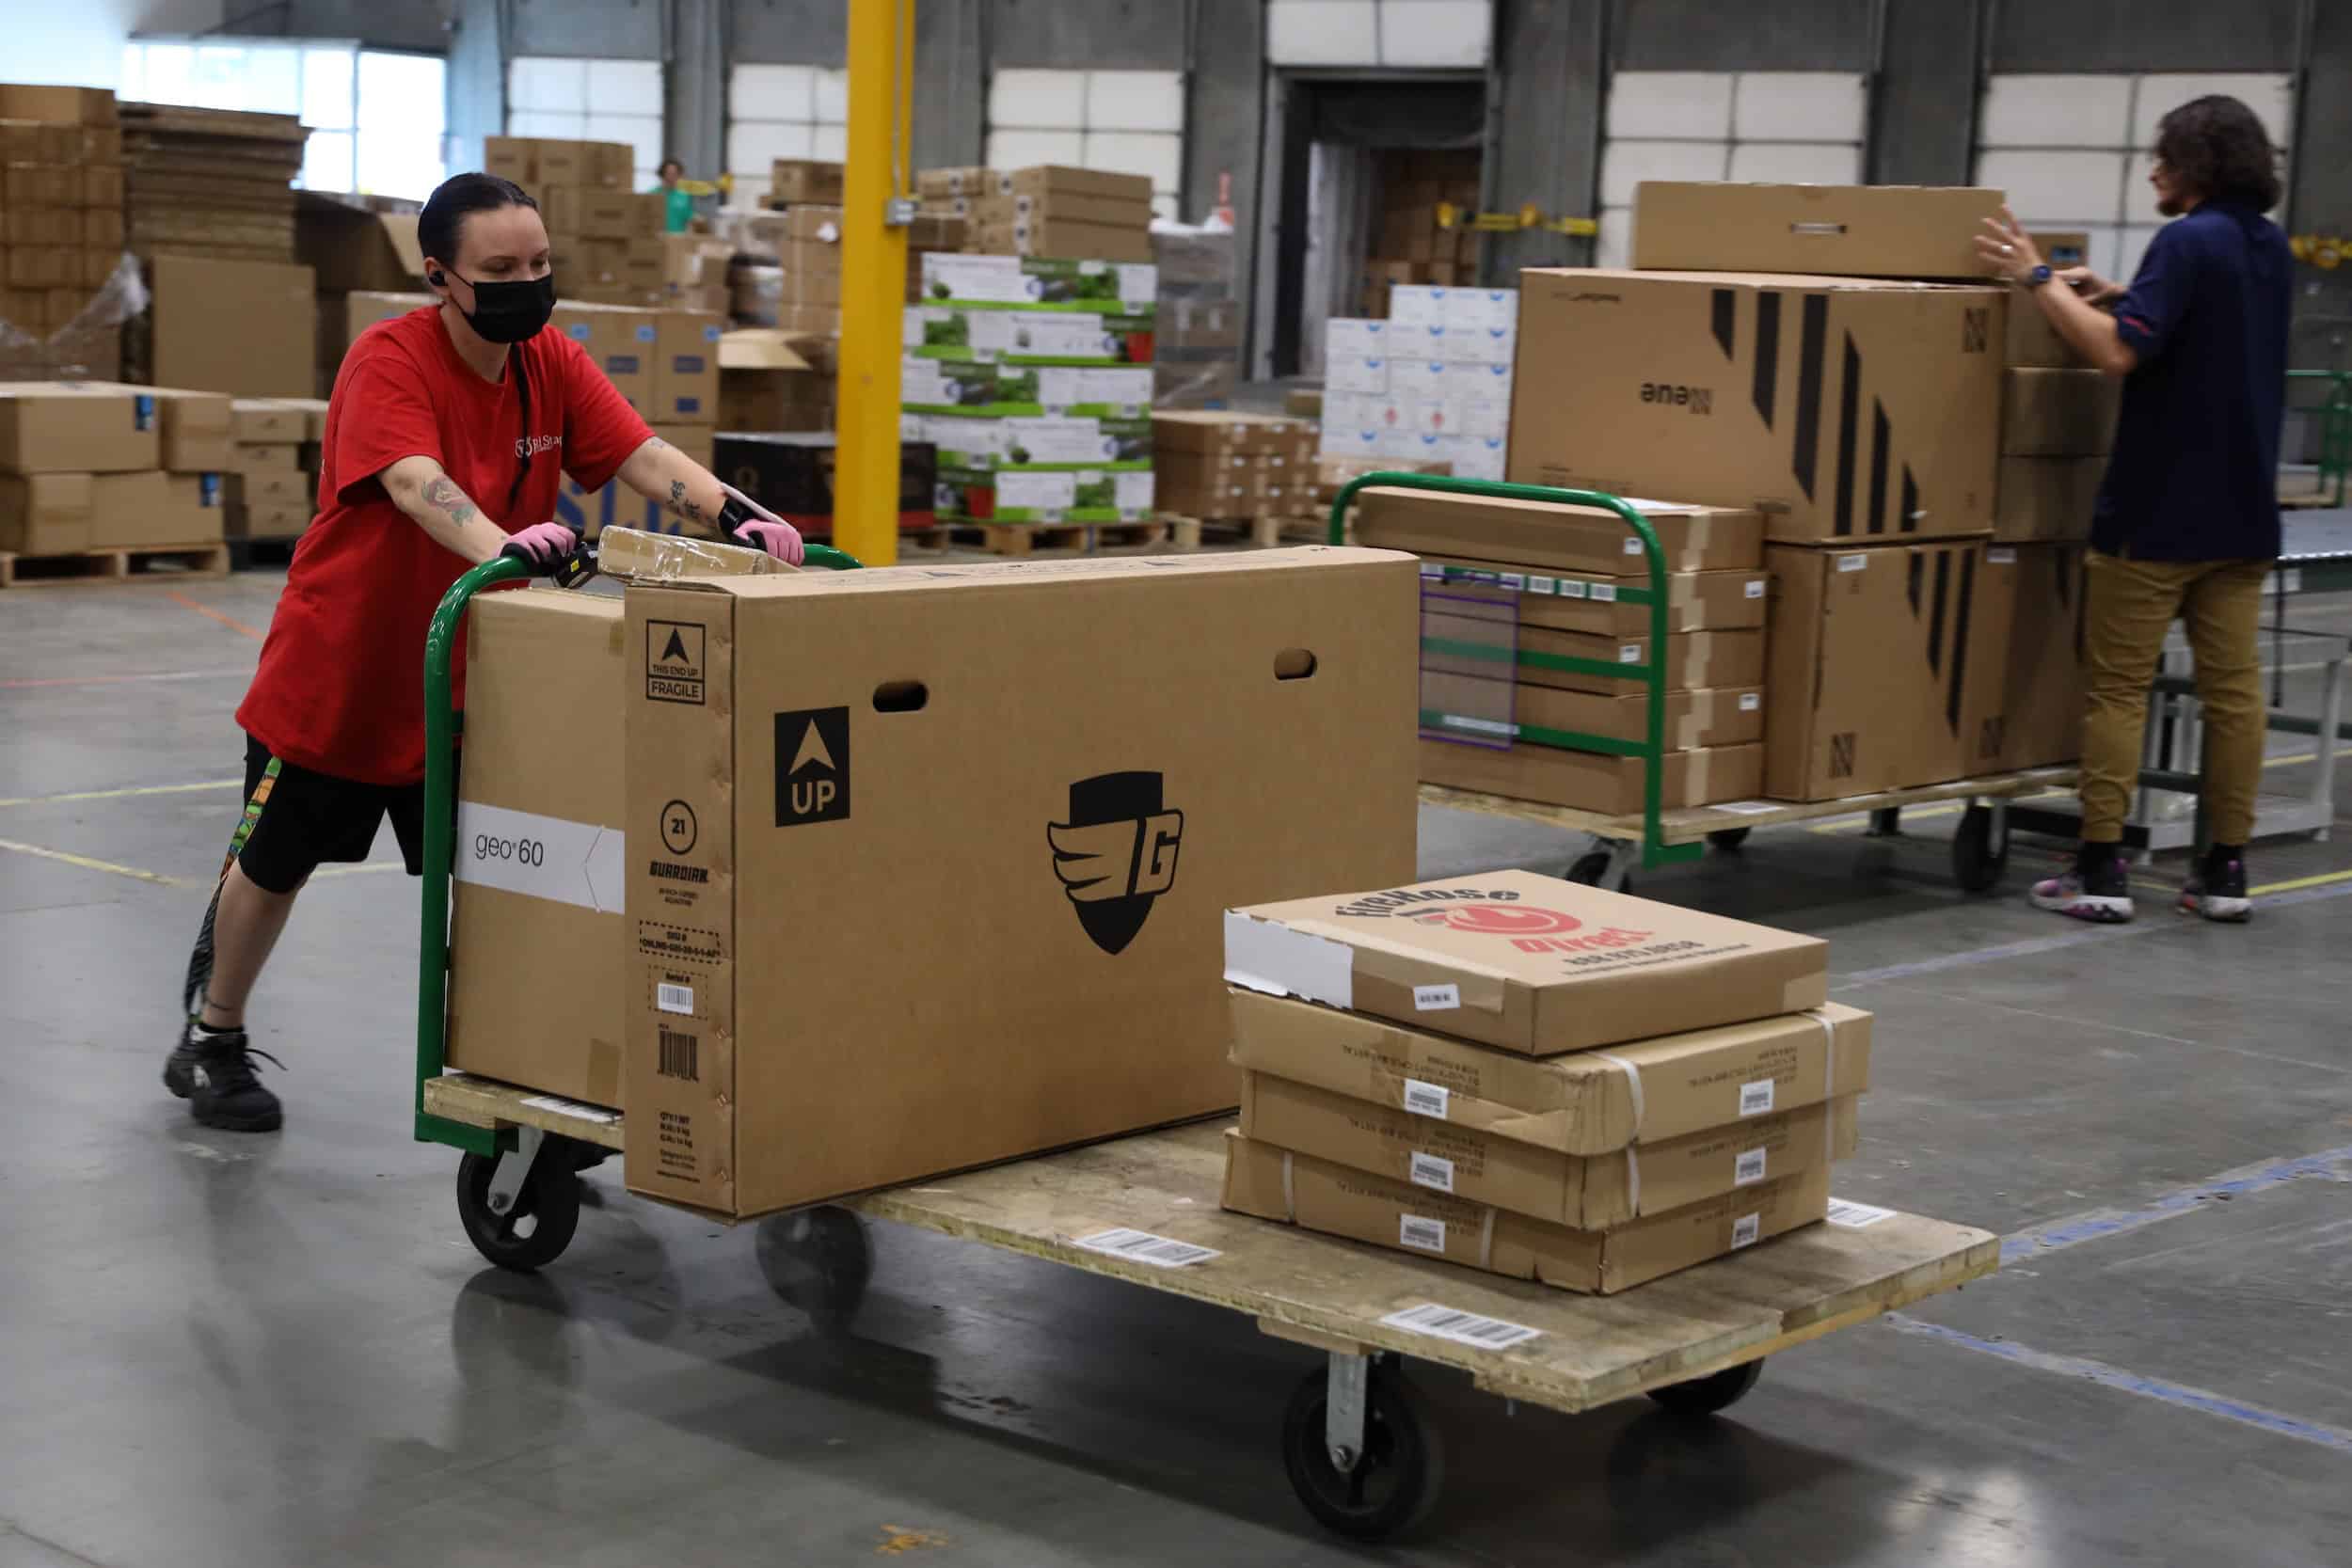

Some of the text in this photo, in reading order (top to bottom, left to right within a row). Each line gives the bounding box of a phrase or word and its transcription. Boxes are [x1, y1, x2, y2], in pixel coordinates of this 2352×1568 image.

[653, 663, 698, 677] THIS END UP
[651, 680, 699, 698] FRAGILE
[791, 780, 836, 815] UP
[671, 818, 685, 835] 21
[518, 838, 544, 867] 60
